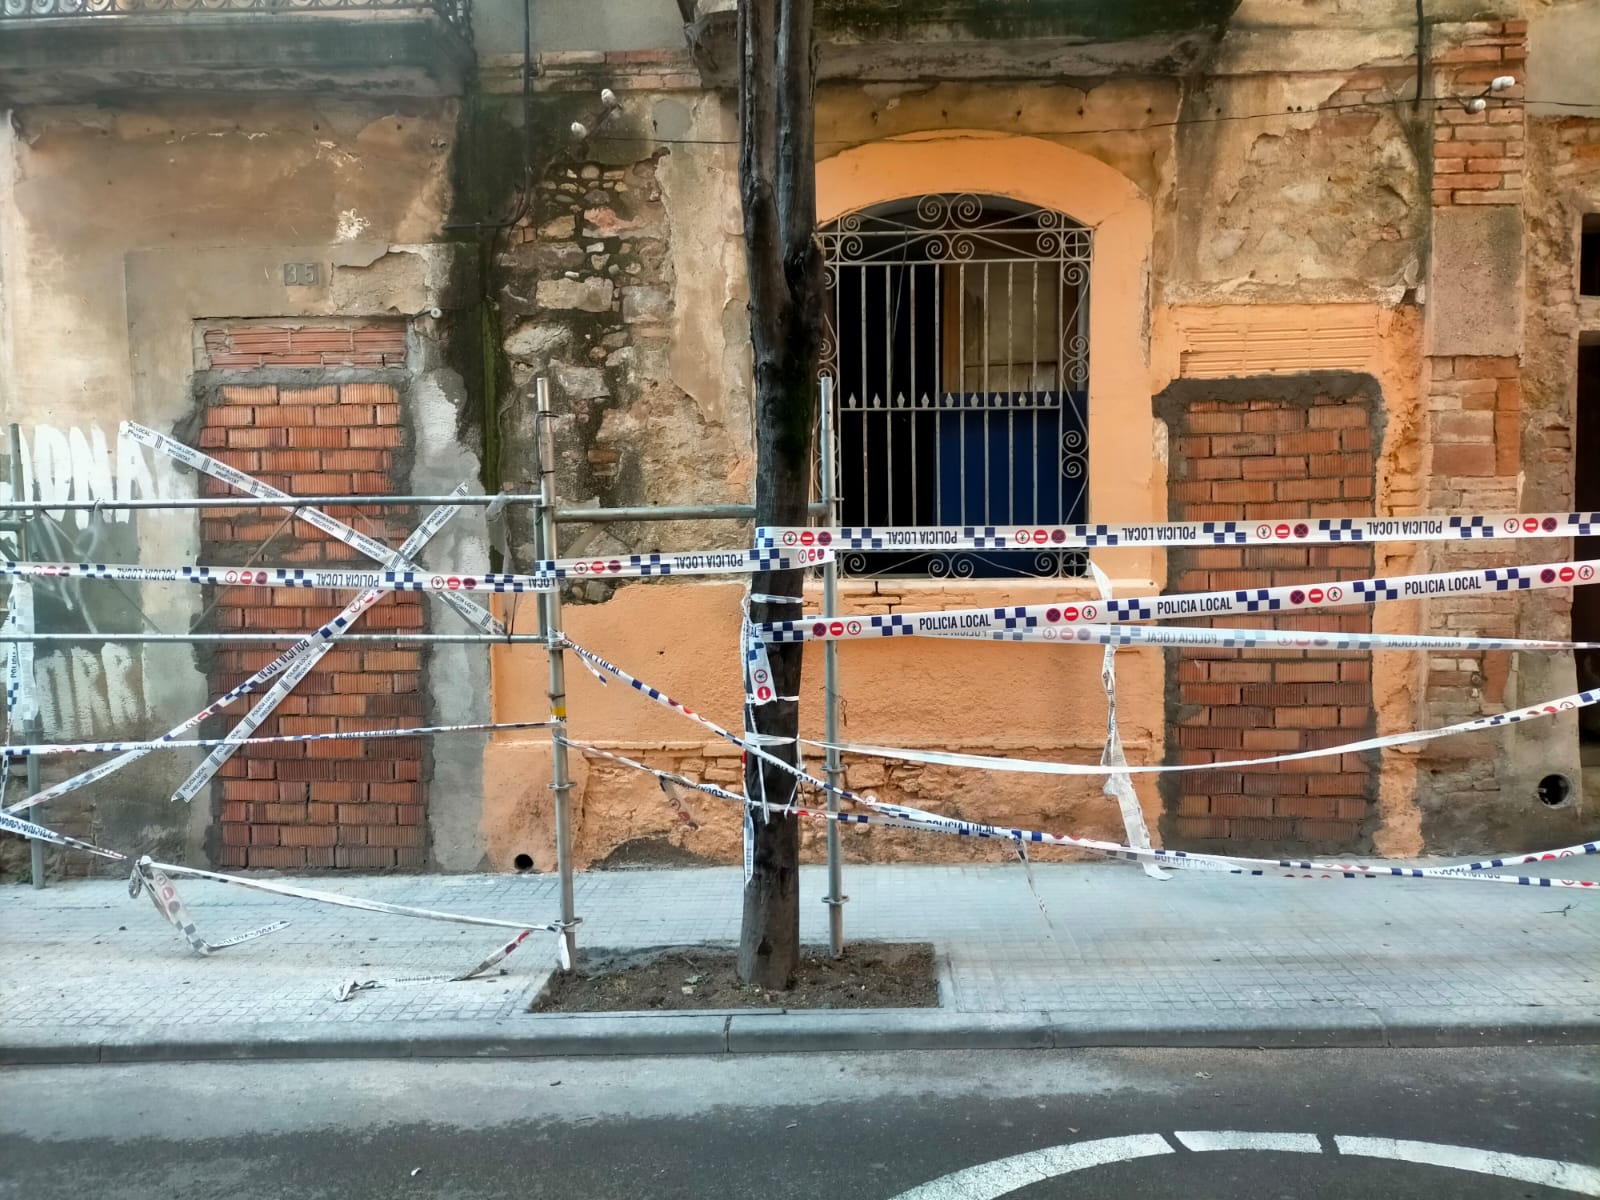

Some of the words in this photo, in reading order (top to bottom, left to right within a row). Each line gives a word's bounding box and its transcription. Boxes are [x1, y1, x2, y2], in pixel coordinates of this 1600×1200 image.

[1122, 527, 1154, 541] LOCAL
[1157, 526, 1197, 540] POLICIA
[1367, 521, 1400, 535] LOCAL
[1402, 520, 1442, 535] POLICIA
[886, 531, 917, 545] LOCAL
[919, 531, 957, 545] POLICIA
[673, 556, 703, 570] LOCAL
[706, 553, 743, 568] POLICIA
[116, 567, 143, 580] LOCAL
[145, 568, 177, 581] POLICIA
[315, 572, 343, 586] LOCAL
[345, 573, 379, 588] POLICIA
[1404, 580, 1446, 595] POLICIA
[1448, 576, 1482, 591] LOCAL
[1157, 600, 1198, 615] POLICIA
[1200, 597, 1232, 612] LOCAL
[919, 616, 957, 631] POLICIA
[960, 613, 991, 629] LOCAL
